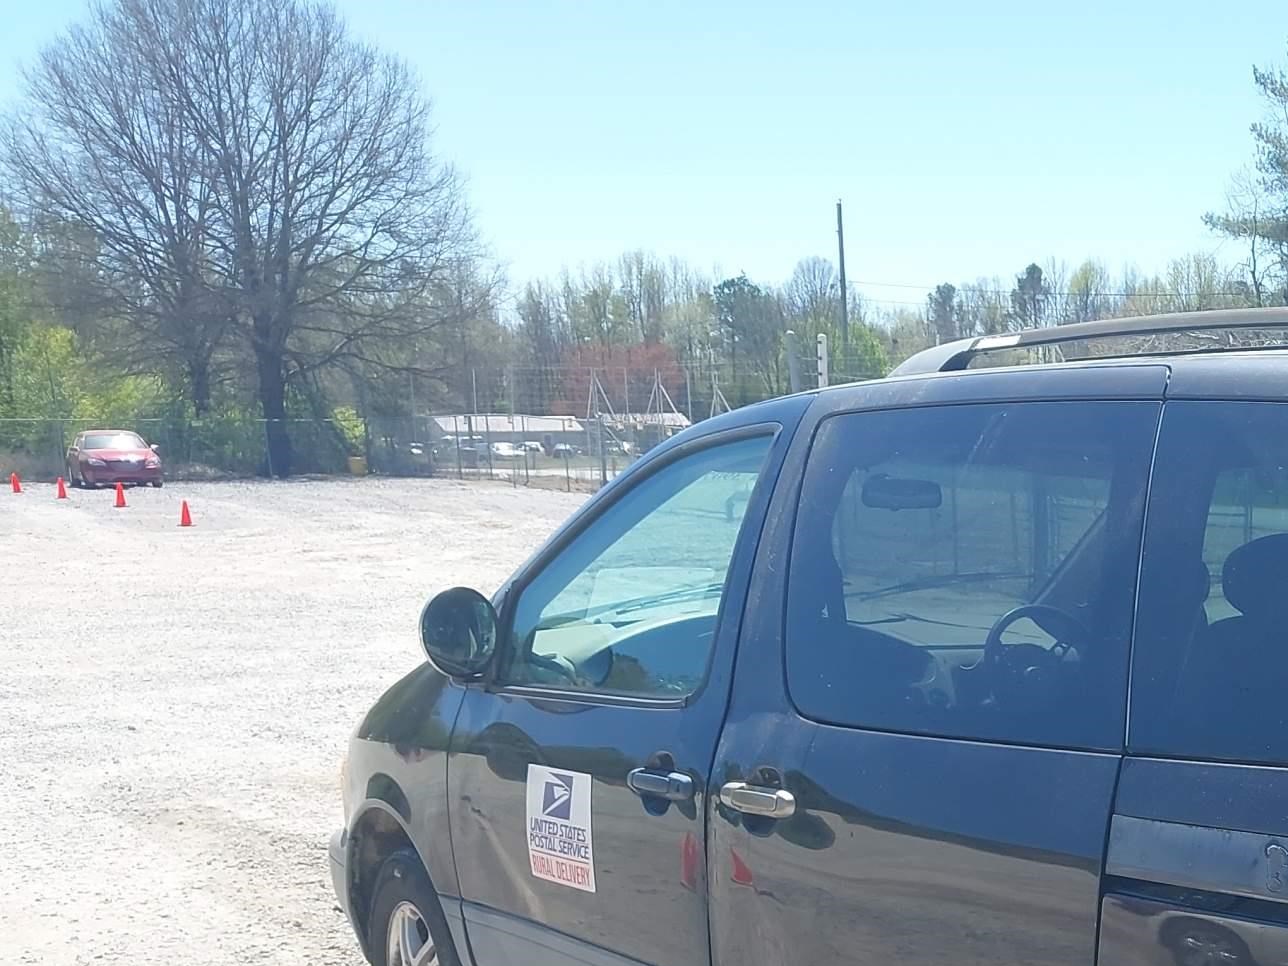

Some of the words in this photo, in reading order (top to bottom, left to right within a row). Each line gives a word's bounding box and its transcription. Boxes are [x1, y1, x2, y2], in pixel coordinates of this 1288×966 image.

[530, 816, 559, 837] UNITED
[559, 824, 586, 843] STATES
[529, 832, 556, 852] POSTAL
[558, 839, 590, 860] SERVICE
[532, 854, 556, 878] RURAL
[556, 861, 591, 887] DELIVERY
